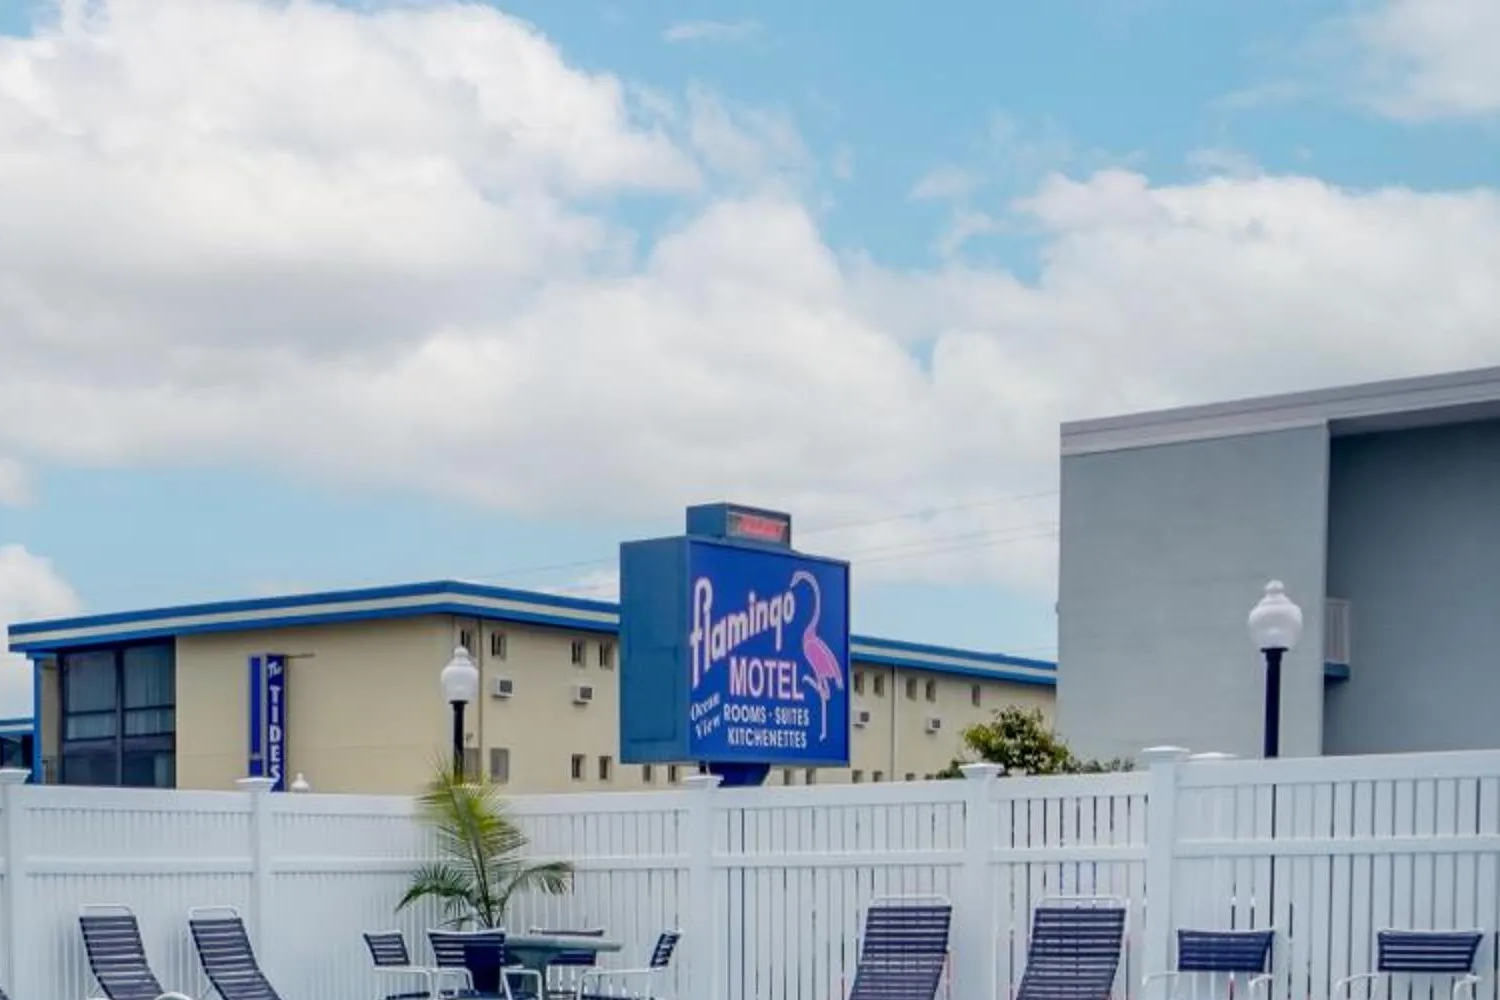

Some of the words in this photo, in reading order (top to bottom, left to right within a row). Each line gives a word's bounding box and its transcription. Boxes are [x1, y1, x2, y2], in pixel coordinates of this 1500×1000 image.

[690, 577, 795, 690] flamingo
[729, 655, 805, 700] MOTEL
[691, 692, 720, 721] Ocean
[723, 703, 767, 724] ROOMS
[775, 705, 810, 727] SUITES
[269, 684, 282, 782] TIDES
[695, 714, 721, 740] View
[727, 727, 808, 749] KITCHENETTES
